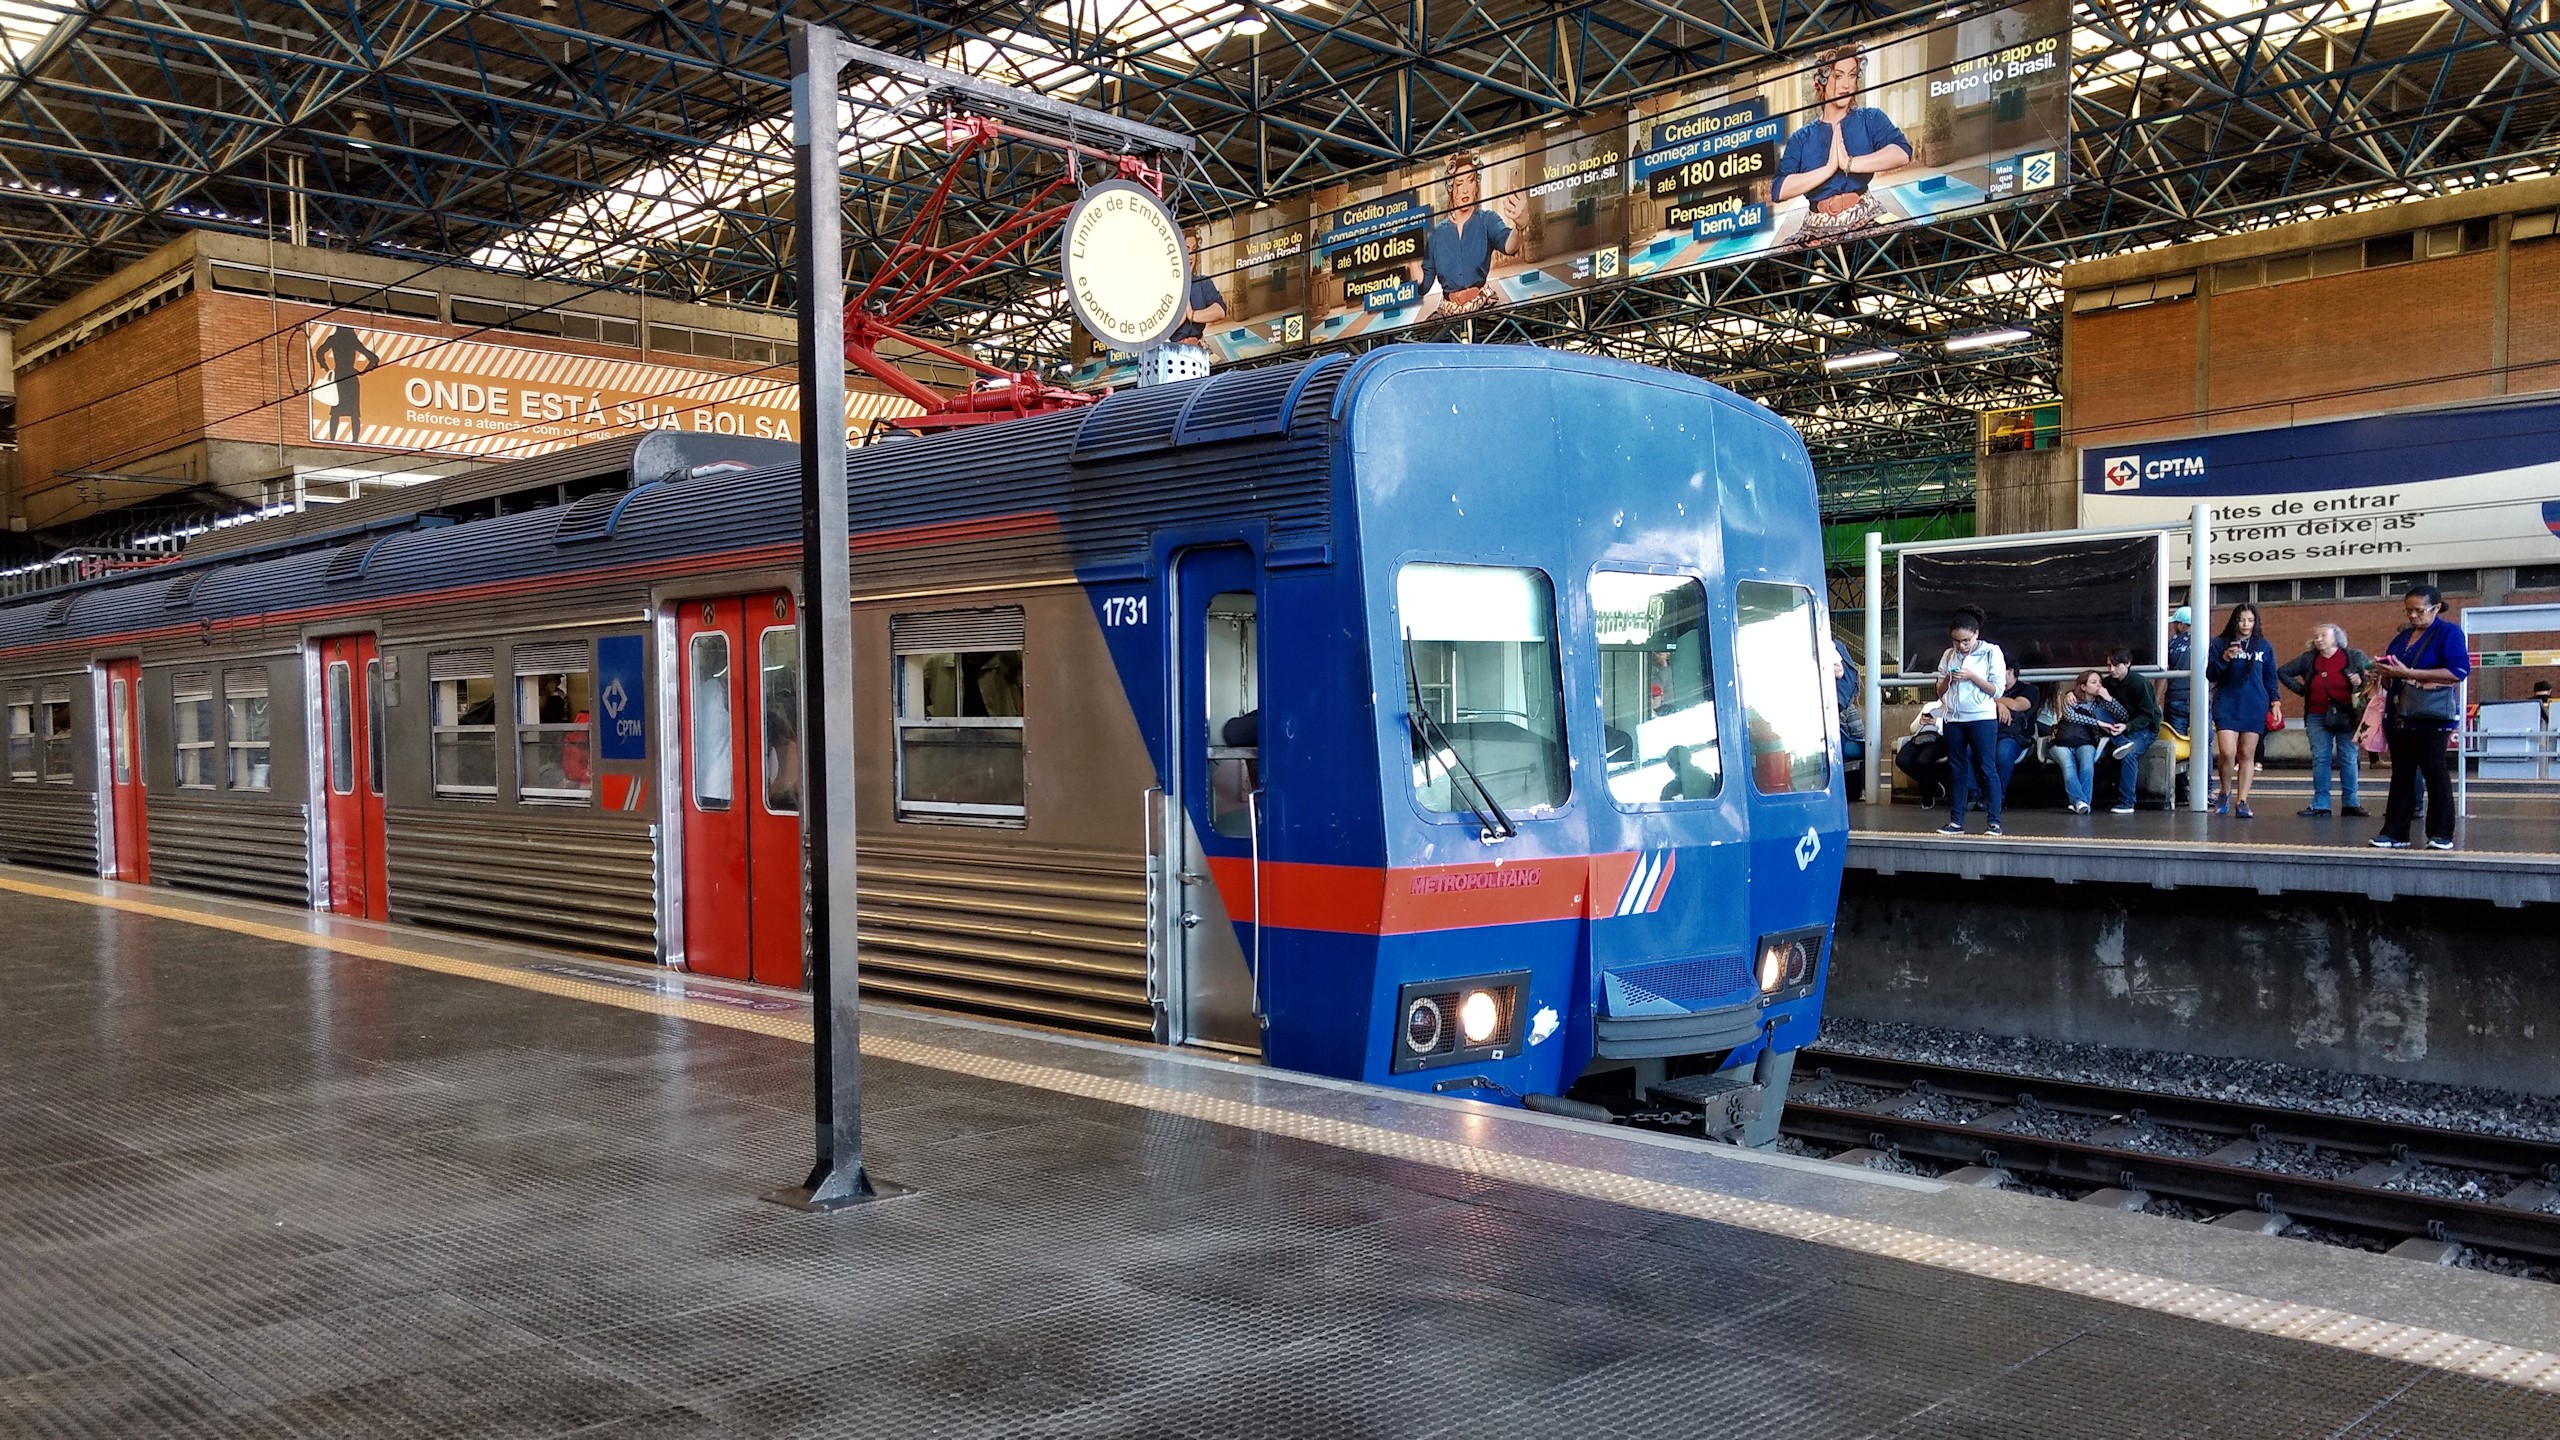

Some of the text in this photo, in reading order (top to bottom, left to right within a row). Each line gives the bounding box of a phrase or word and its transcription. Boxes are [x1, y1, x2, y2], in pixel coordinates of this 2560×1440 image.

[2000, 44, 2032, 62] app
[2034, 37, 2057, 54] do
[1930, 51, 2056, 98] Banco do Brasil.
[1665, 110, 1753, 142] Crédito para
[1644, 123, 1777, 167] começar a pagar em
[1543, 150, 1618, 179] Vai no app do
[1657, 152, 1763, 194] até 180 dias
[1996, 165, 2013, 175] Mais
[1530, 180, 1564, 197] Banco
[1566, 174, 1581, 188] do
[1990, 181, 2013, 192] Digital
[1999, 174, 2013, 184] que
[1343, 201, 1408, 226] Crédito para
[1700, 207, 1761, 236] bem, dá!
[1073, 196, 1181, 279] Limite de Embarque
[1246, 231, 1303, 255] Vai no app do
[1236, 254, 1263, 270] Banco
[1263, 250, 1275, 262] do
[1337, 237, 1416, 269] até 180 dias
[1078, 276, 1174, 336] e ponto de parada
[1369, 284, 1415, 308] bem, dá!
[404, 377, 793, 442] ONDE ESTÁ SUA BOLSA
[406, 409, 460, 427] Reforce
[464, 419, 472, 427] a
[532, 425, 560, 436] com
[563, 428, 579, 437] os
[582, 429, 611, 441] seus
[2145, 456, 2205, 480] CPTM
[2188, 493, 2400, 521] ntes de entrar
[2226, 525, 2286, 542] trem
[2296, 514, 2372, 536] deixe
[2305, 540, 2412, 559] saírem.
[1102, 594, 1149, 626] 1731
[616, 718, 642, 737] CPTM
[1410, 868, 1541, 895] METROPOLITANO
